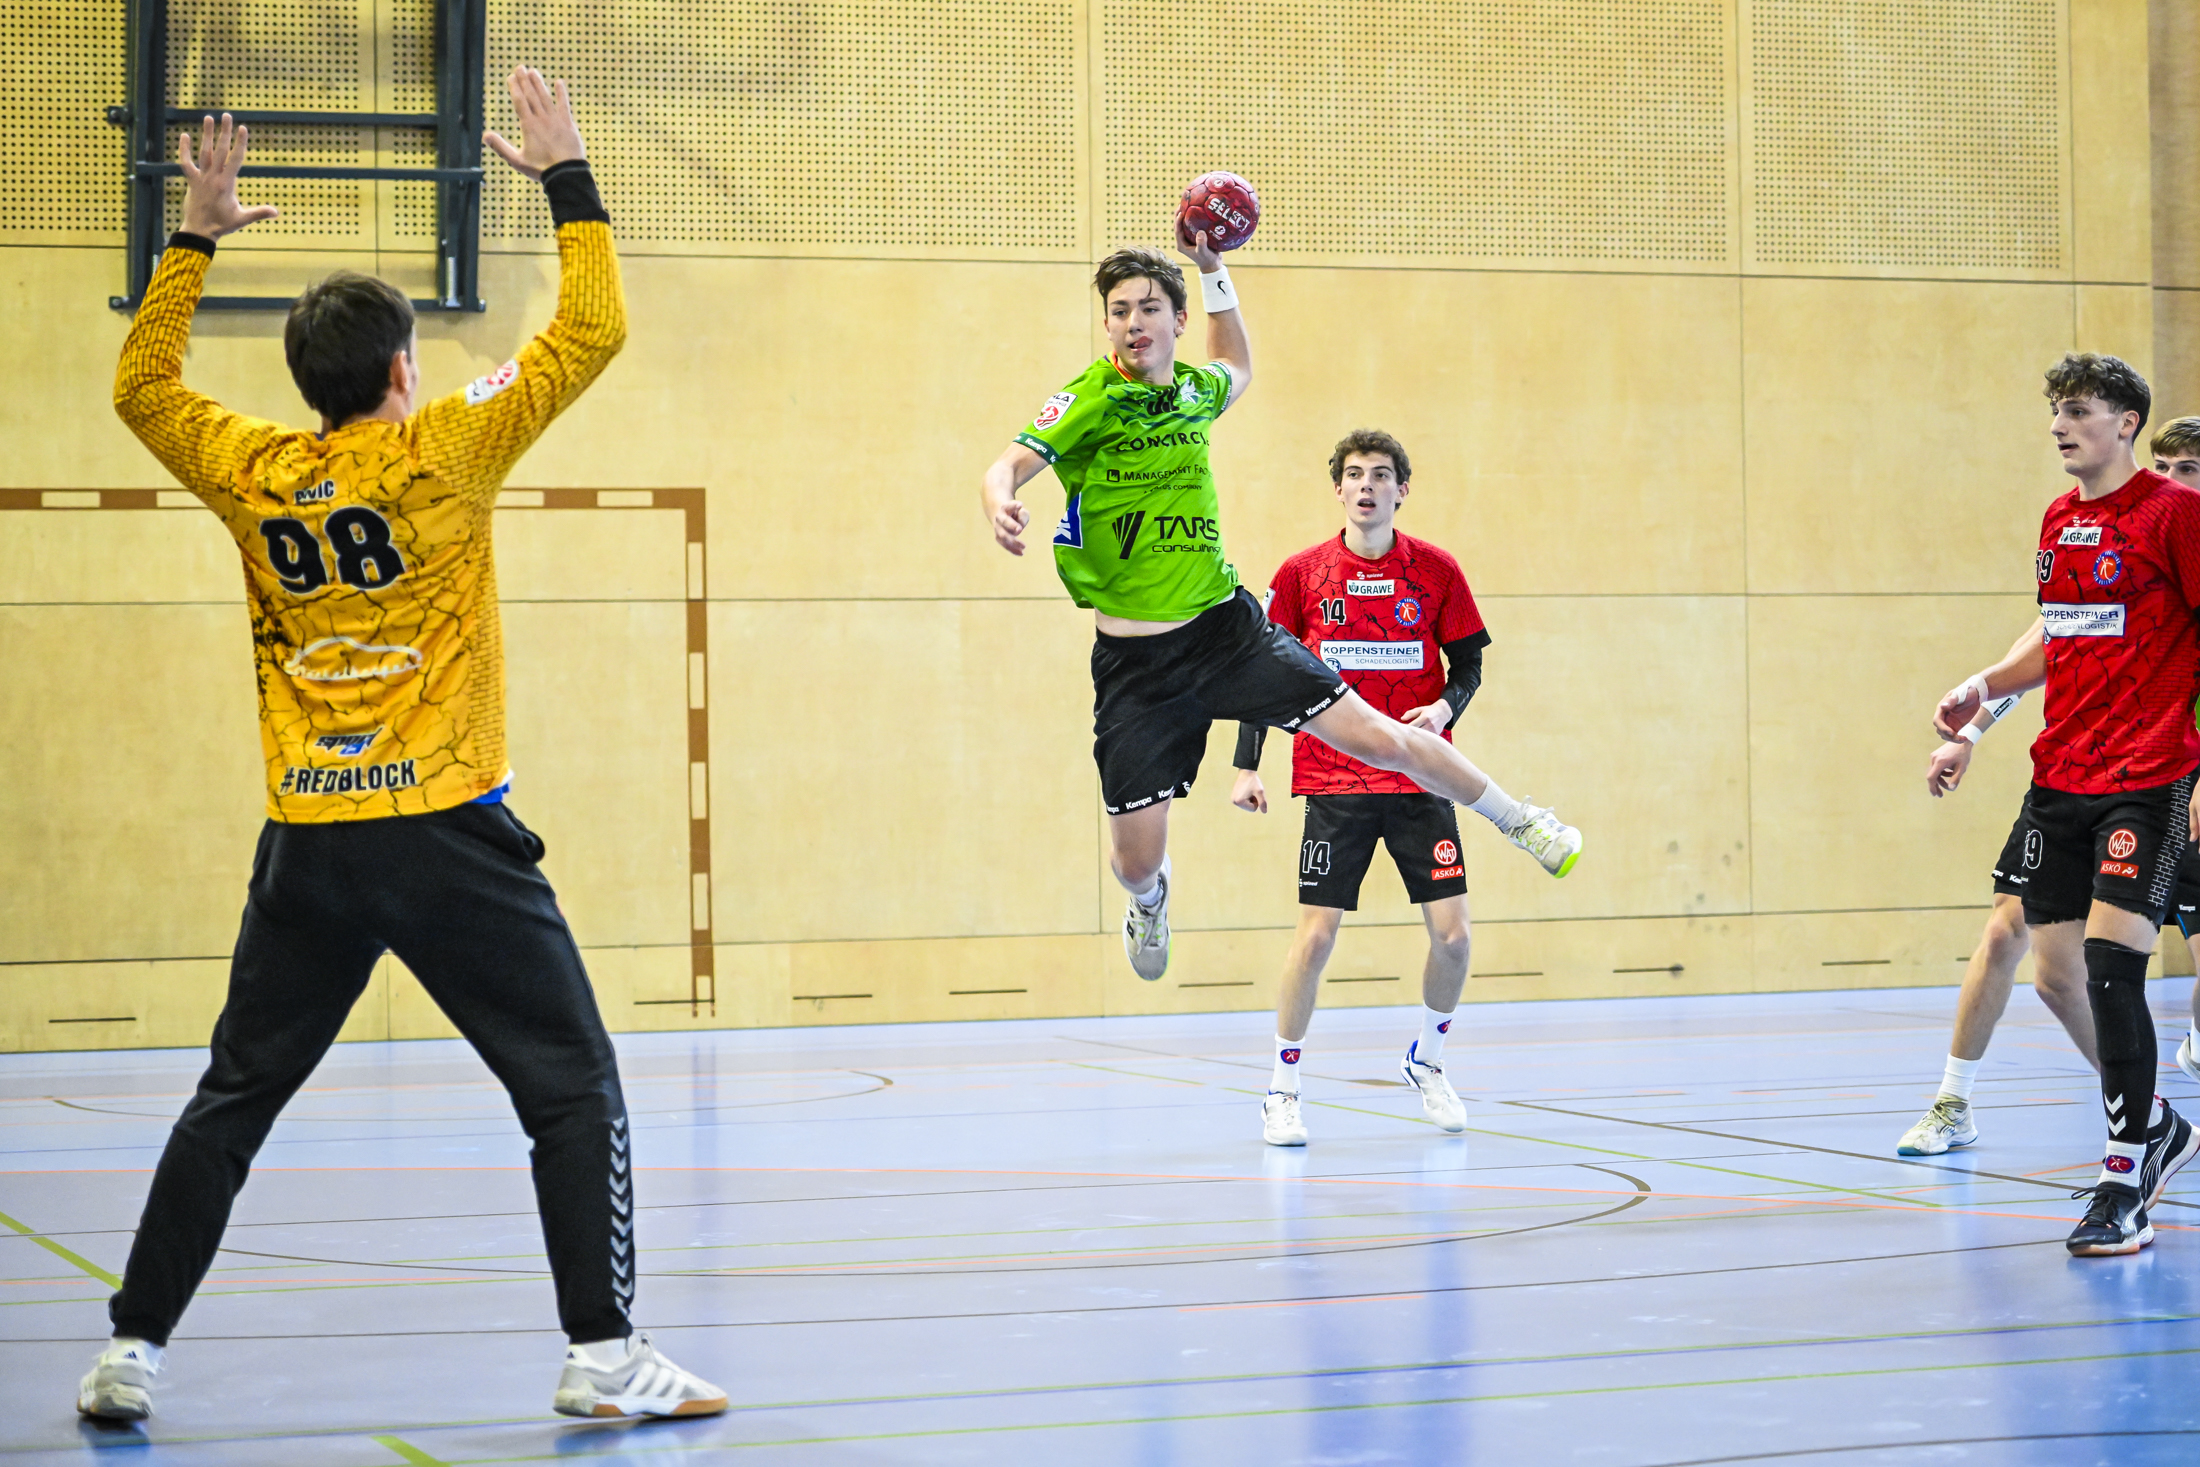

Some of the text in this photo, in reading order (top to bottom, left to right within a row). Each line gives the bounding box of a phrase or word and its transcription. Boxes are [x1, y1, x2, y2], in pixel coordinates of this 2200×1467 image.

[1207, 197, 1251, 232] SELECT
[1154, 515, 1219, 541] TARS
[2069, 532, 2099, 544] GRAWE
[259, 506, 406, 594] 98
[1360, 585, 1393, 595] GRAWE
[1320, 598, 1346, 625] 14
[1323, 646, 1420, 655] KOPPENSTEINER
[1305, 697, 1331, 717] Kempa
[280, 759, 416, 794] #REDBLOCK
[1125, 797, 1152, 810] Kempa
[1302, 840, 1330, 875] 14
[1434, 869, 1455, 878] ASKÖ
[2101, 863, 2121, 873] ASKÖ
